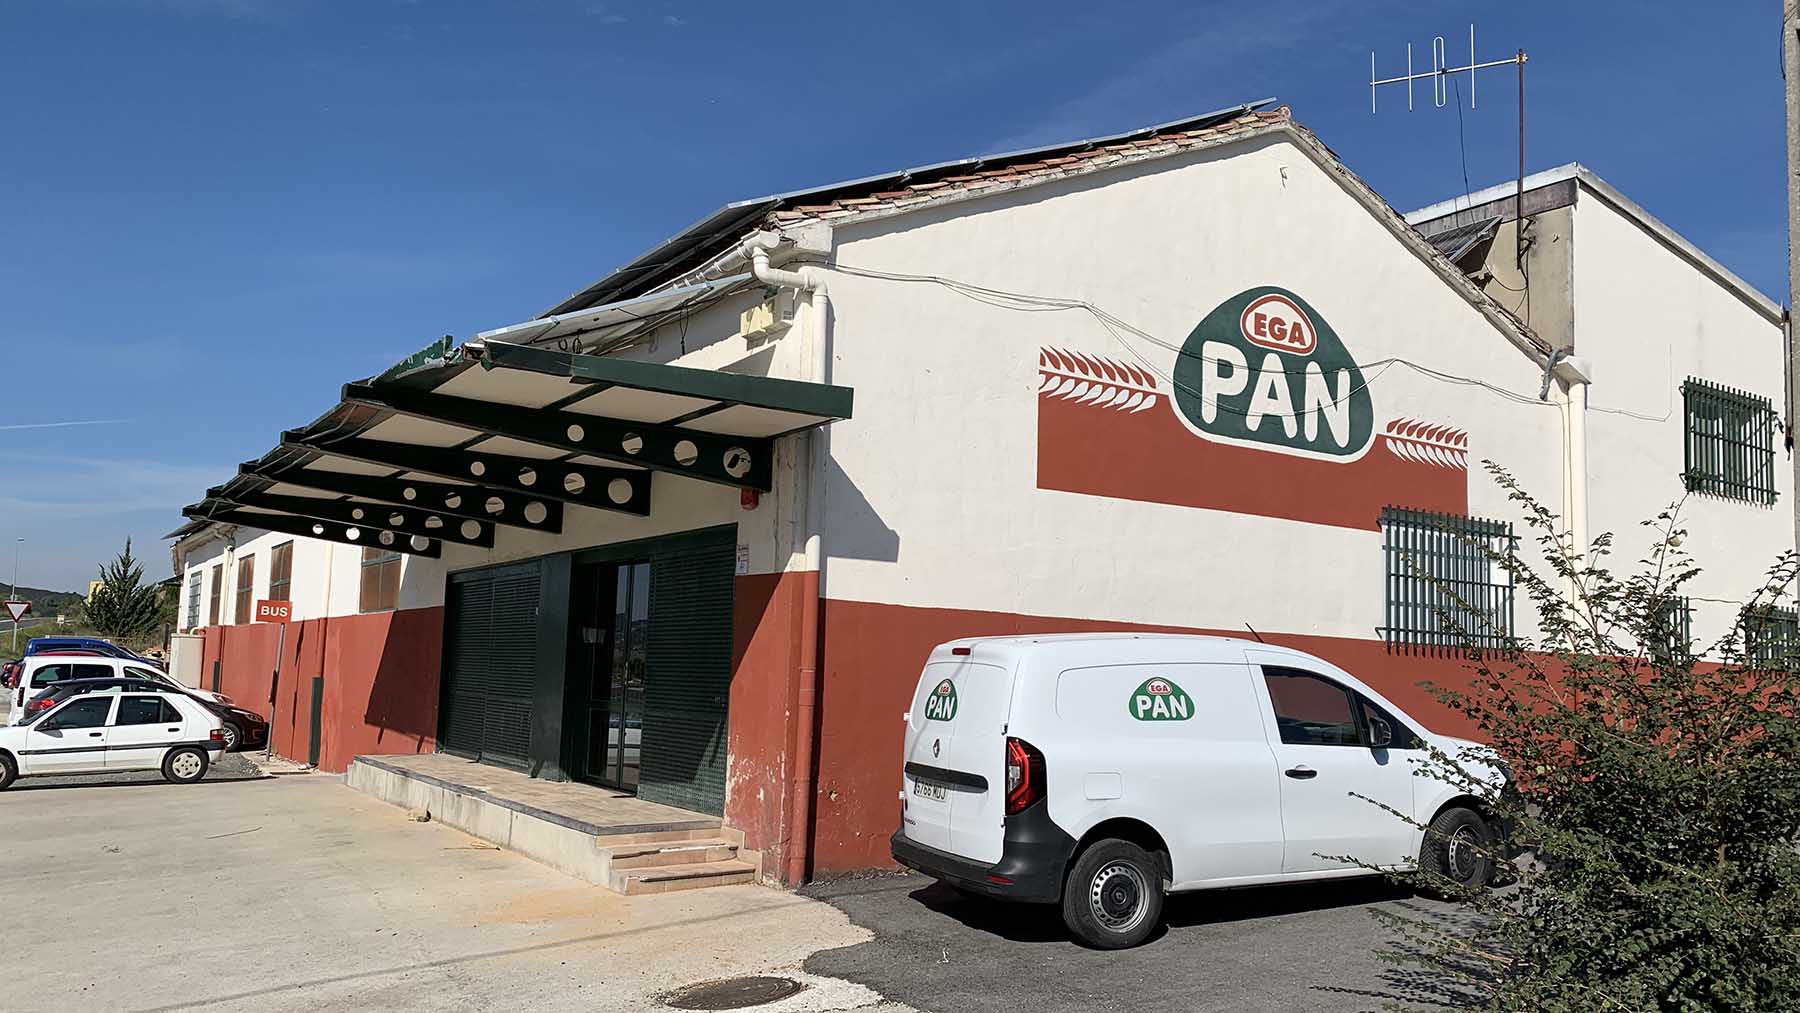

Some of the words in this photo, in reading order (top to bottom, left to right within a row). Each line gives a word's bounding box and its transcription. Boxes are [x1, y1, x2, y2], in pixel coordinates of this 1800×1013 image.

[1254, 312, 1306, 347] EGA
[1201, 340, 1350, 448] PAN
[261, 605, 288, 617] BUS
[927, 695, 955, 719] PAN
[1136, 695, 1188, 718] PAN
